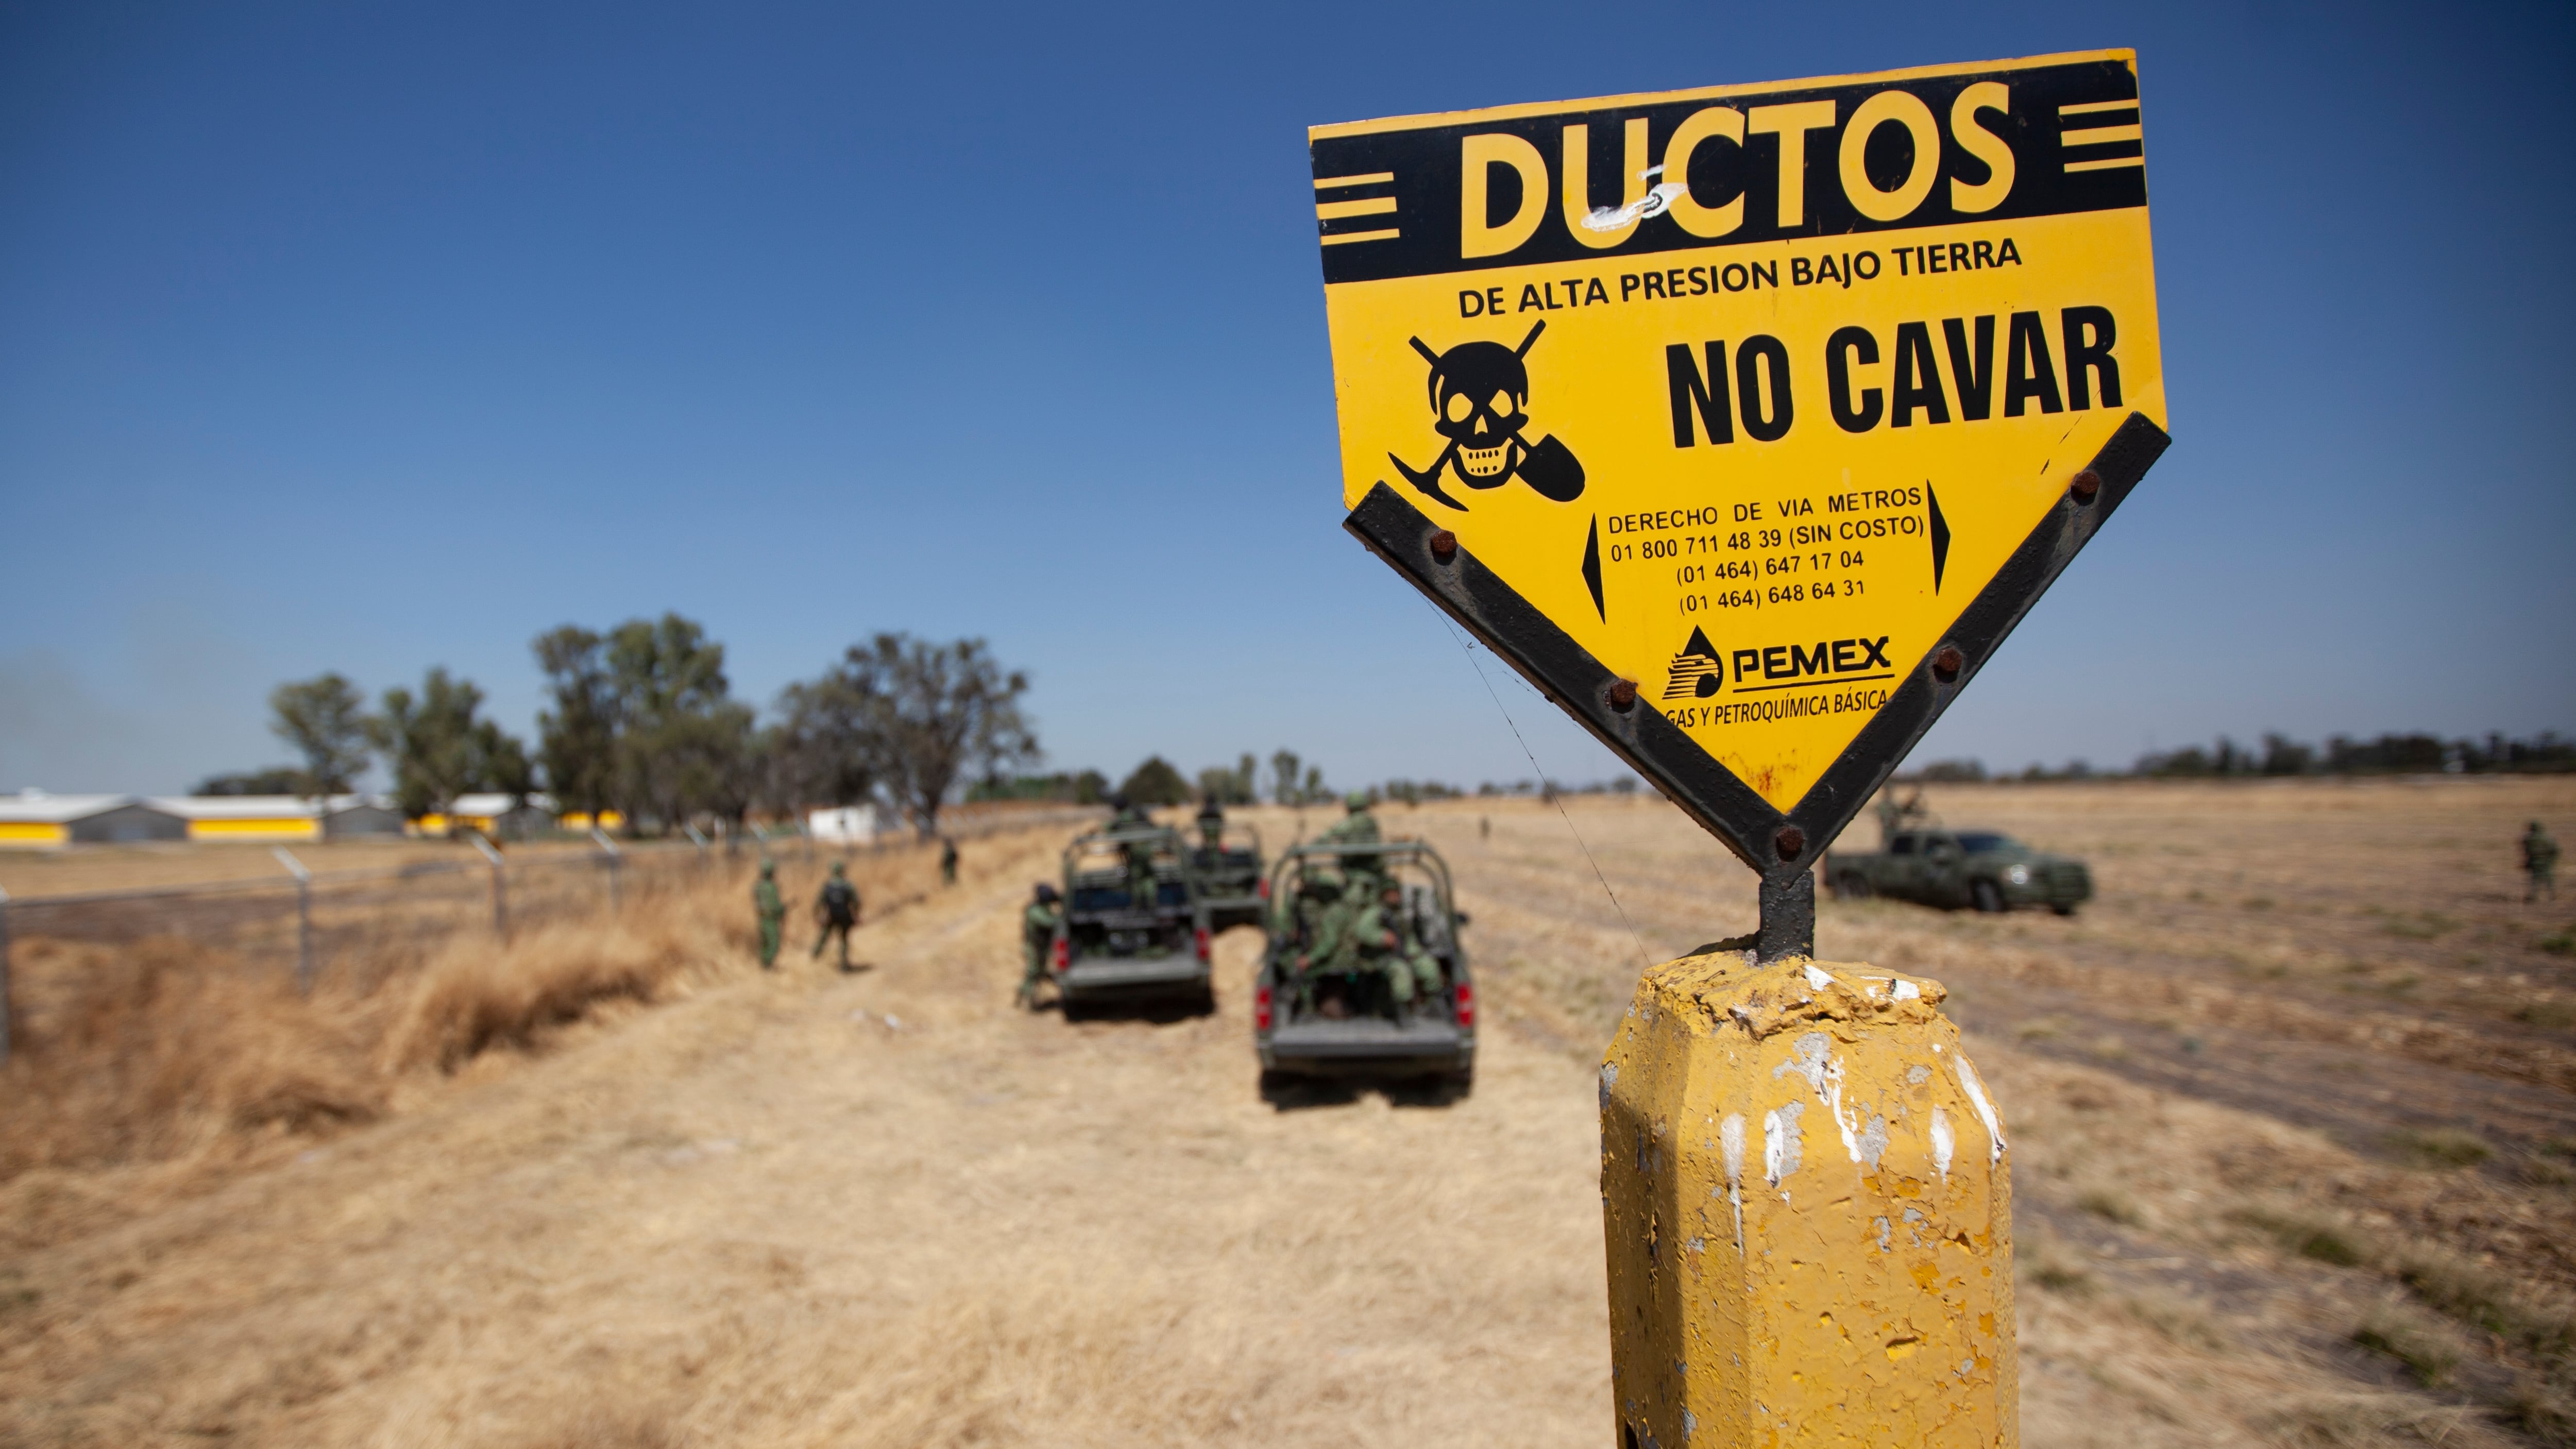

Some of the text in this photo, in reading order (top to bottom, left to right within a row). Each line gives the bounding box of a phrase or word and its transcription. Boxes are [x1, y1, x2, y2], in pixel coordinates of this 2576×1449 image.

[1462, 82, 2015, 259] DUCTOS
[1460, 238, 2022, 317] DE ALTA PRESION BAJO TIERRA
[1666, 306, 2123, 448] NO CAVAR
[1609, 488, 1921, 533] DERECHO DE VIA METROS
[1612, 516, 1923, 561] 01 800 711 48 39 (SIN COSTO)
[1677, 551, 1863, 586] (01 464) 647 17 04
[1680, 580, 1863, 615] (01 464) 648 64 31
[1733, 636, 1891, 682] PEMEX
[1665, 686, 1887, 728] GAS Y PETROQUÍMICA BÁSICA
